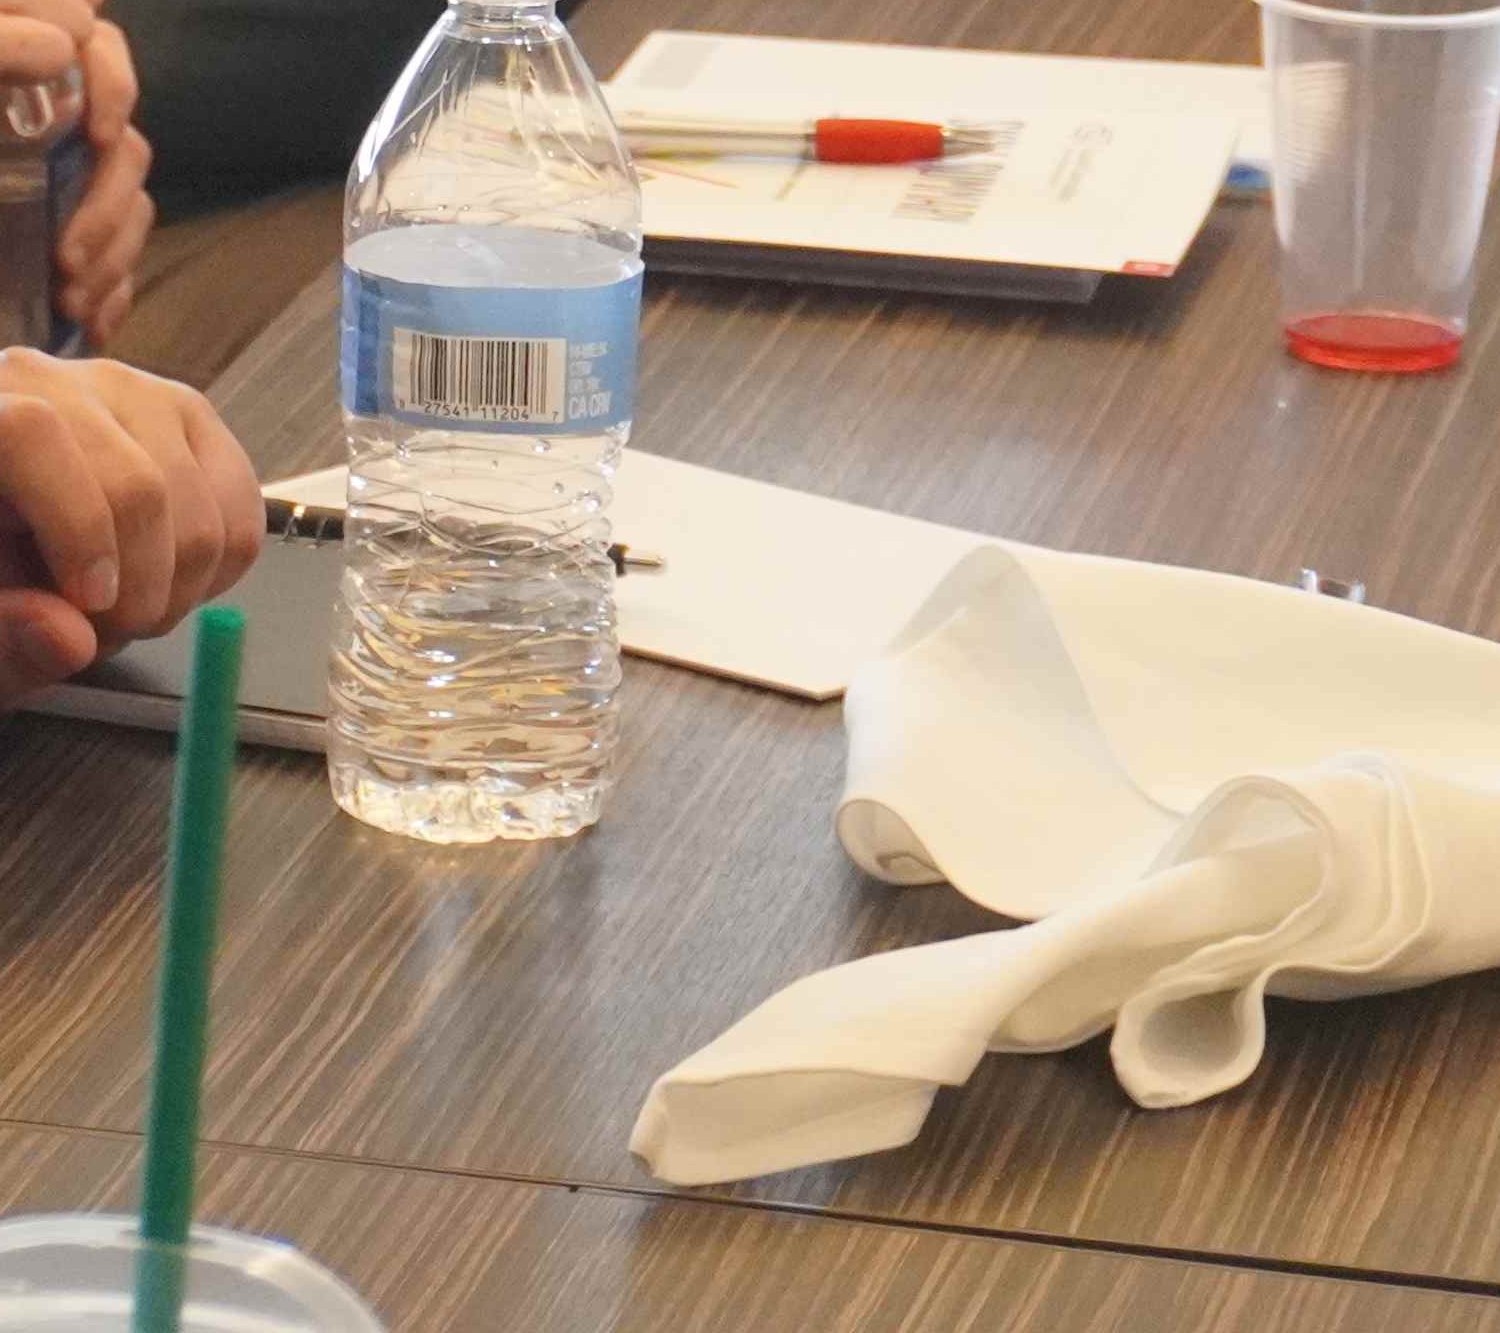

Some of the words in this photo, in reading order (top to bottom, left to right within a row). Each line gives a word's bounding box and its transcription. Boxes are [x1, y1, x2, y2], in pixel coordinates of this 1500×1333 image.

[424, 401, 470, 417] 27541
[482, 406, 530, 420] 11204
[552, 411, 558, 420] 7
